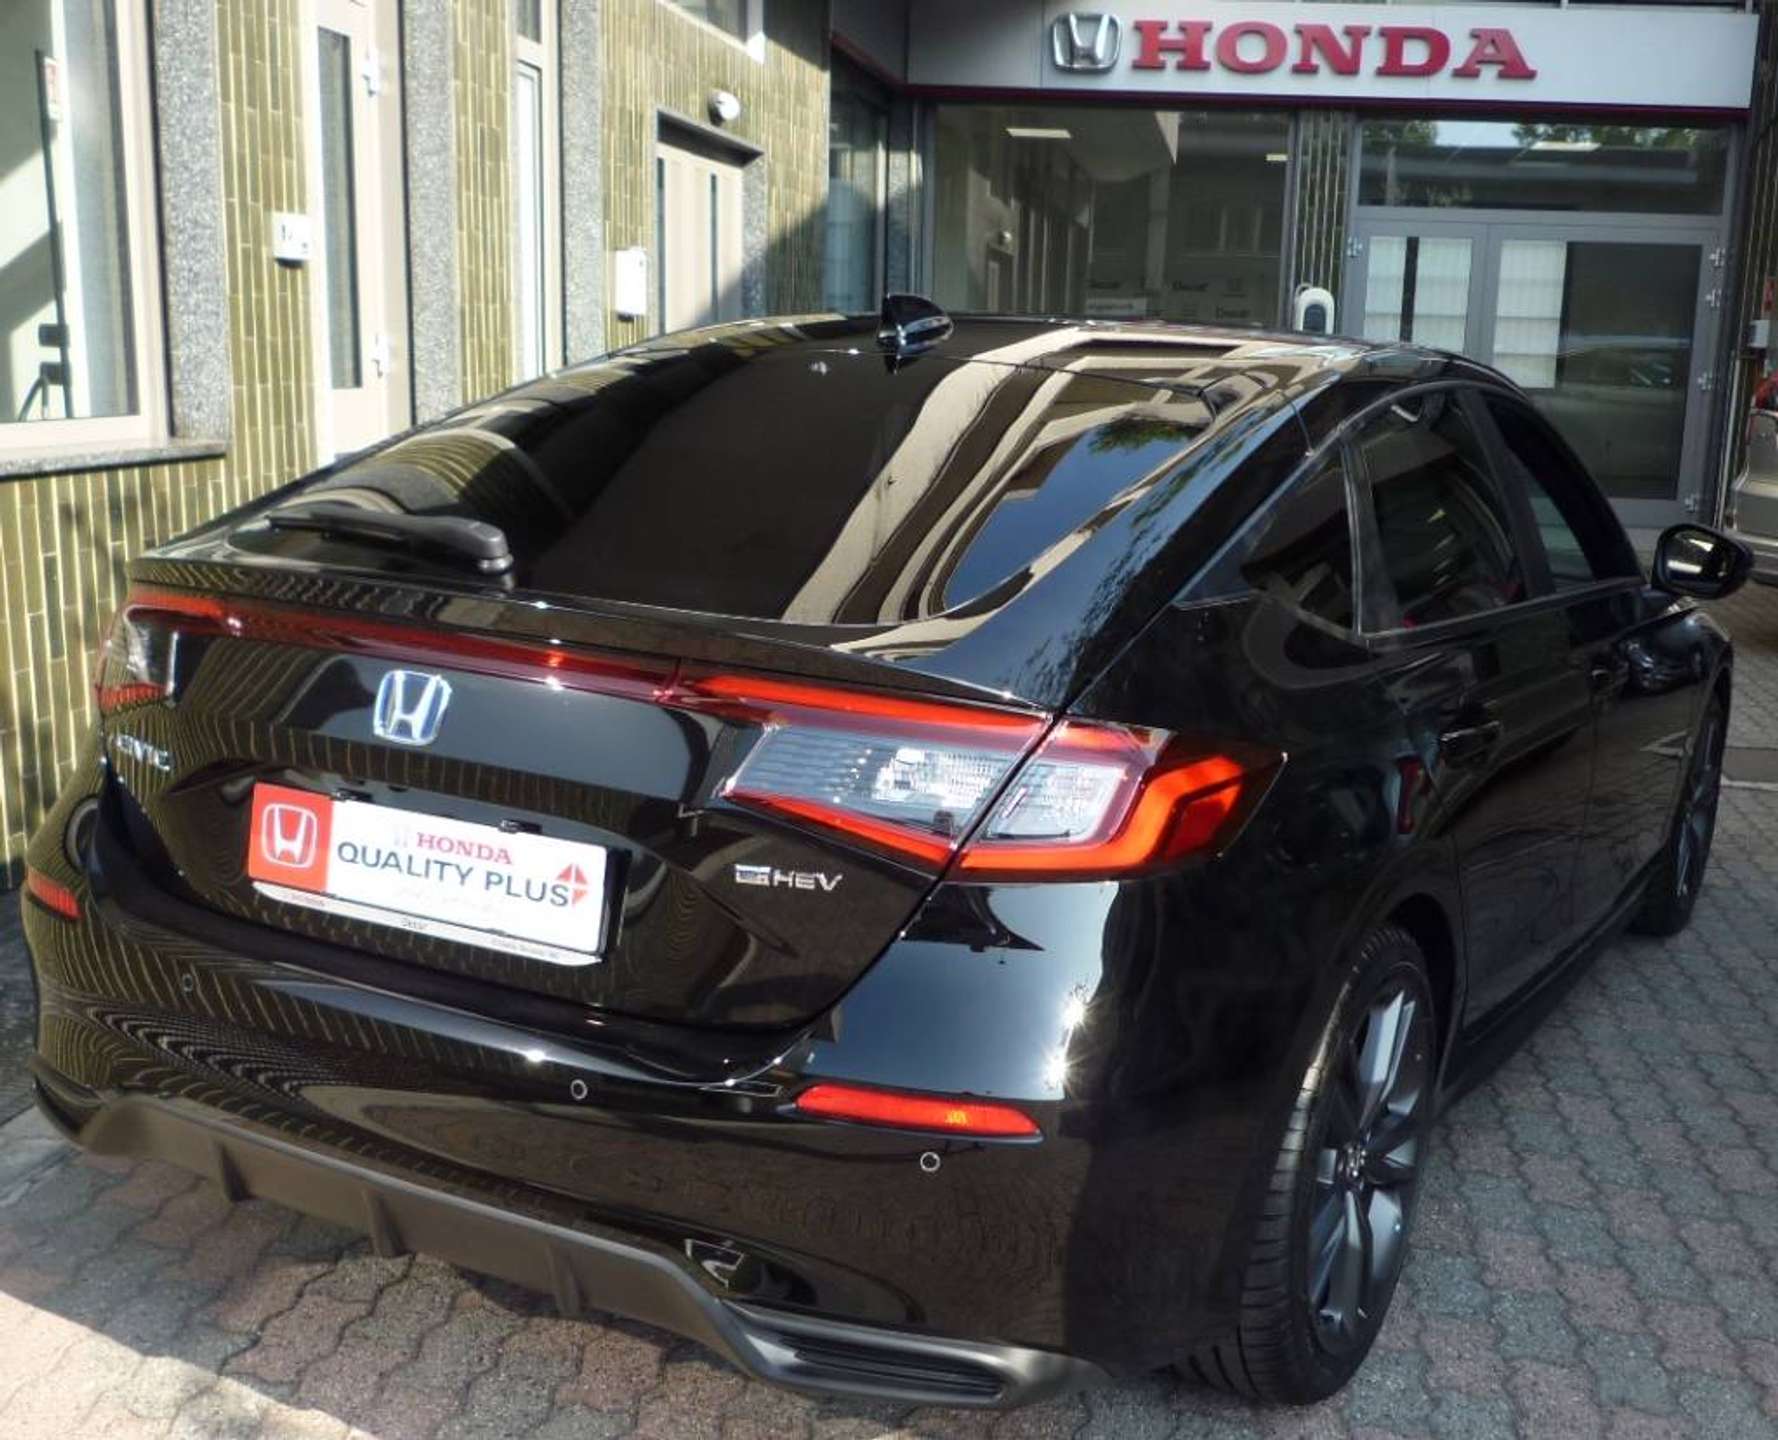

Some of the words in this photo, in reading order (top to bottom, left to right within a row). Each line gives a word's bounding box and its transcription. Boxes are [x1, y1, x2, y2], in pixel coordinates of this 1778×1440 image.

[1132, 20, 1538, 80] HONDA
[336, 841, 474, 887] QUALITY
[484, 870, 570, 908] PLUS
[416, 831, 513, 866] HONDA
